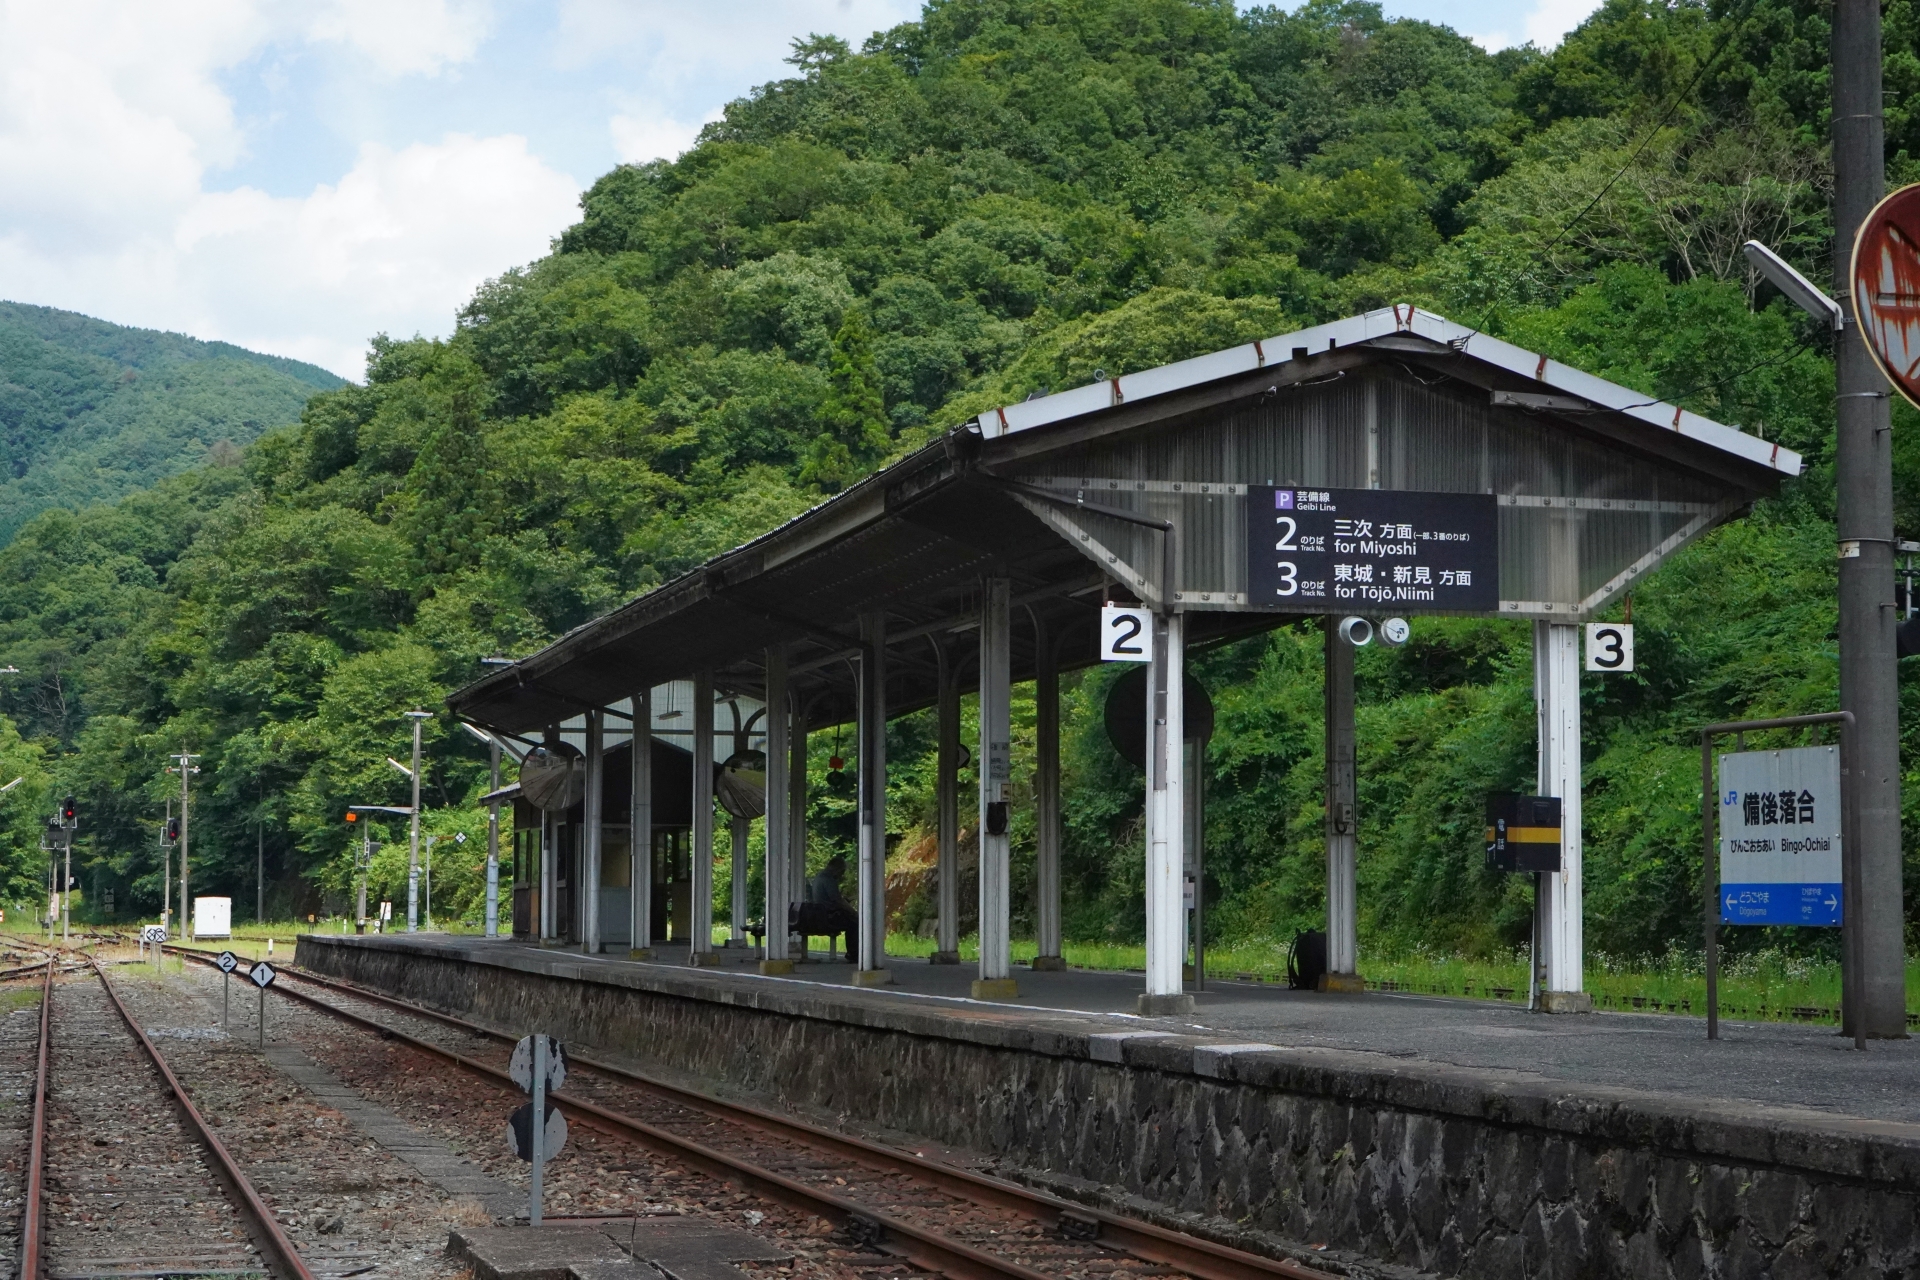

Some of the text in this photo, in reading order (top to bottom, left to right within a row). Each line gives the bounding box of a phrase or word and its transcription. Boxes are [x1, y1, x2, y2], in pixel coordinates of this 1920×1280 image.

[1280, 493, 1289, 507] P
[1296, 491, 1330, 502] 芸備線
[1297, 503, 1318, 511] Geibi
[1275, 516, 1298, 551] 2
[1333, 519, 1373, 538] 三次
[1379, 523, 1412, 540] 方面
[1300, 536, 1325, 545] のりば
[1334, 540, 1417, 557] for Miyoshi
[1276, 561, 1298, 596] 3
[1333, 564, 1472, 587] 東城・新見 方面
[1301, 581, 1325, 590] のりば
[1334, 585, 1357, 599] for
[1111, 614, 1143, 655] 2
[1594, 628, 1625, 668] 3
[1724, 790, 1738, 806] JR
[1743, 789, 1816, 826] 備後落合
[1730, 837, 1831, 855] びんごおちあい Bingo-Ochiai
[1739, 891, 1770, 904] どうごやま
[222, 956, 232, 968] 2
[259, 968, 265, 981] 1
